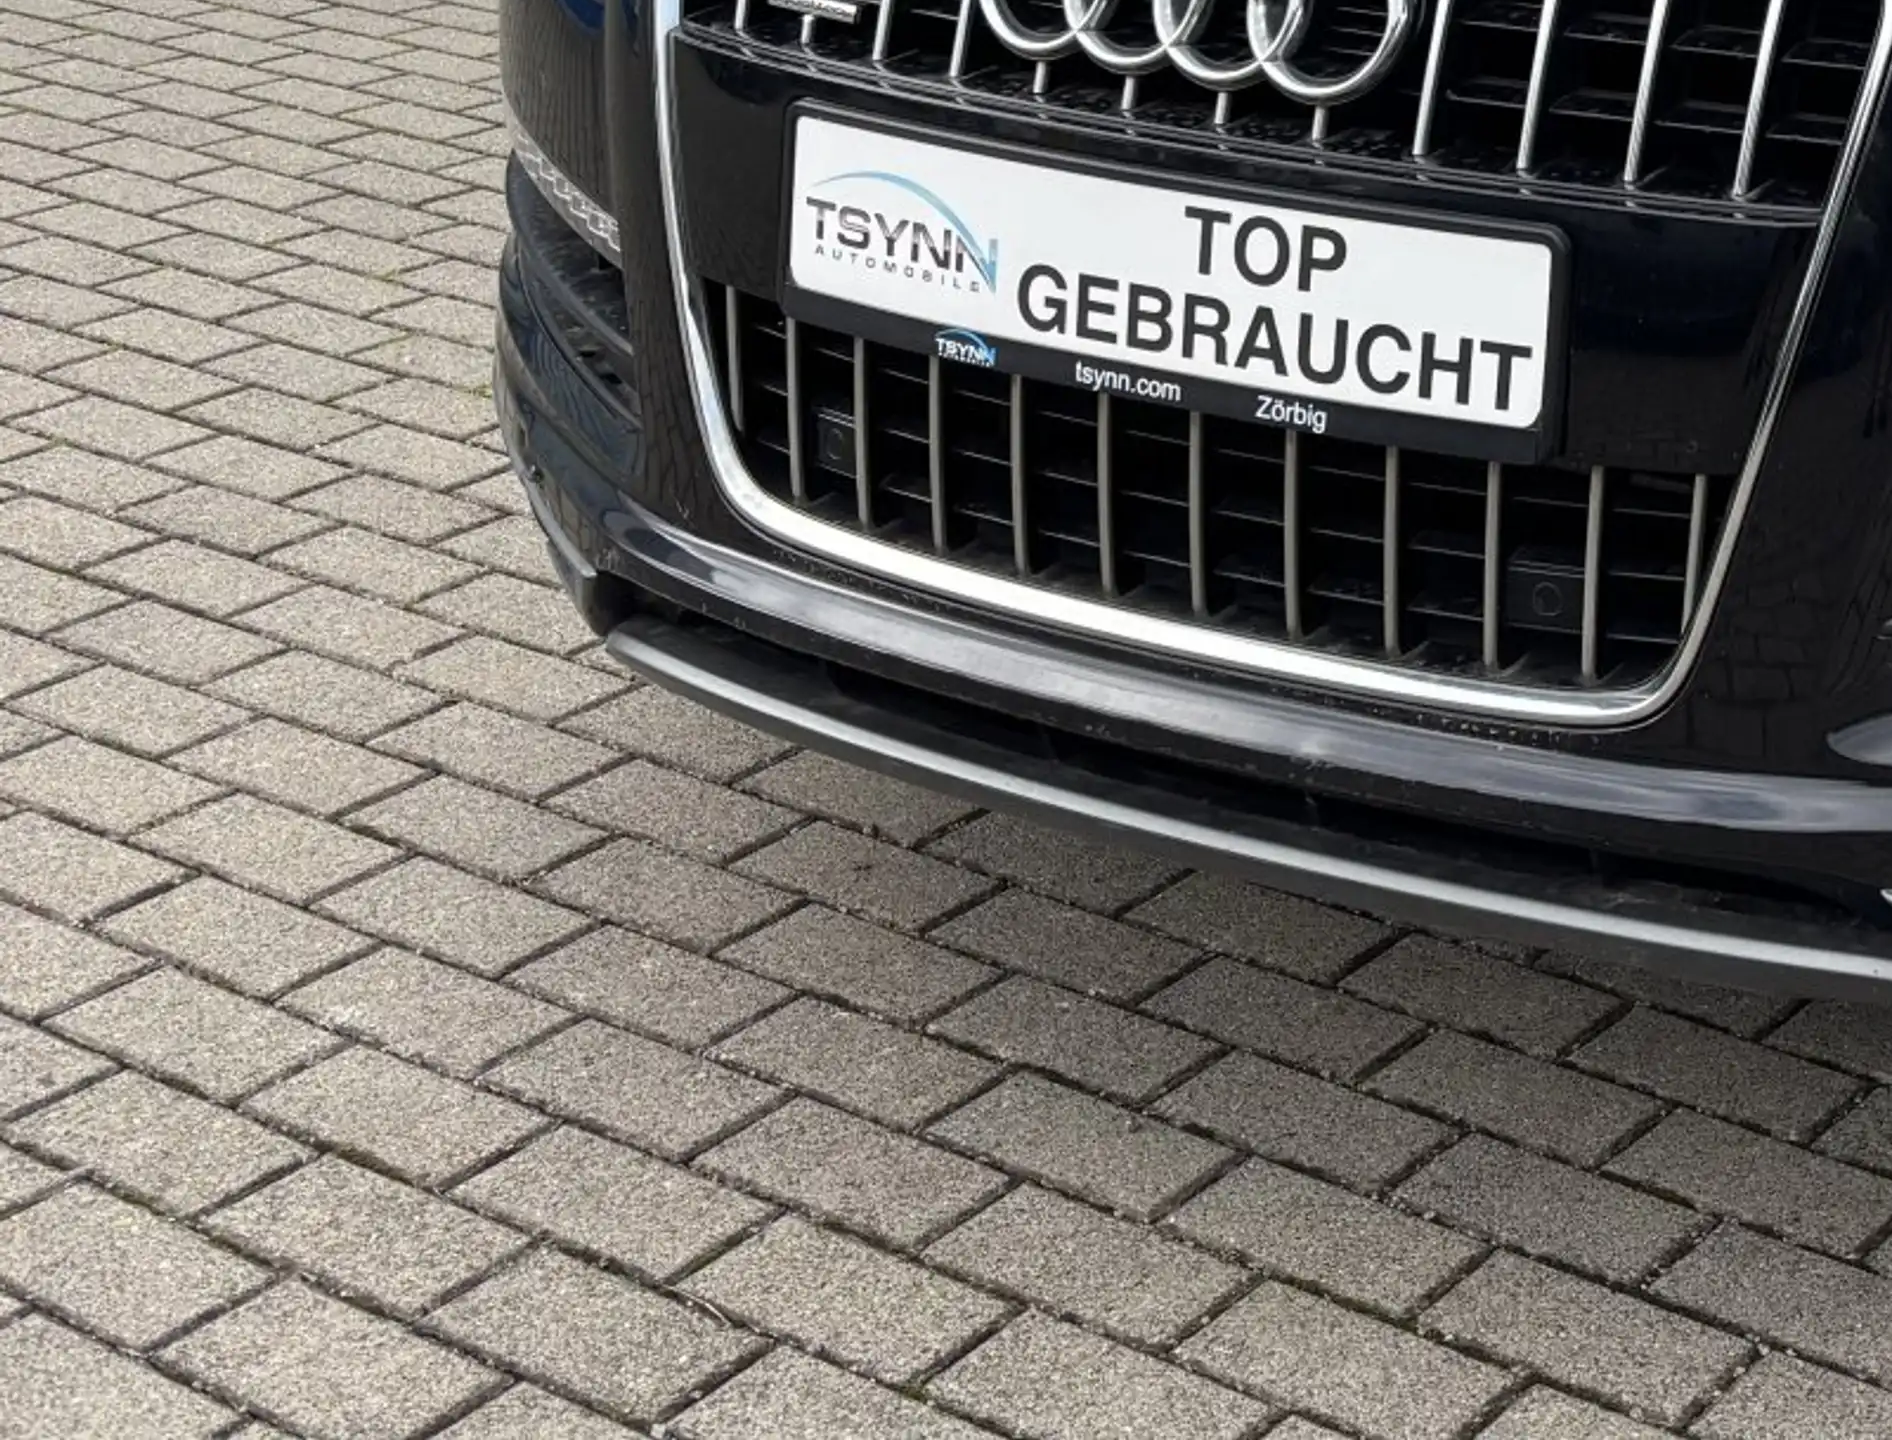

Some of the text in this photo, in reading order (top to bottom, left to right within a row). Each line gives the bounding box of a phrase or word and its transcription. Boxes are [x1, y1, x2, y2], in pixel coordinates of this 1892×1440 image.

[806, 195, 999, 294] TSYNN
[815, 243, 981, 293] AUTOMOBILE
[1184, 205, 1348, 292] TOP
[1016, 262, 1534, 412] GEBRAUCHT
[1074, 360, 1182, 403] tsynn.com
[1254, 394, 1328, 435] Zörbig
